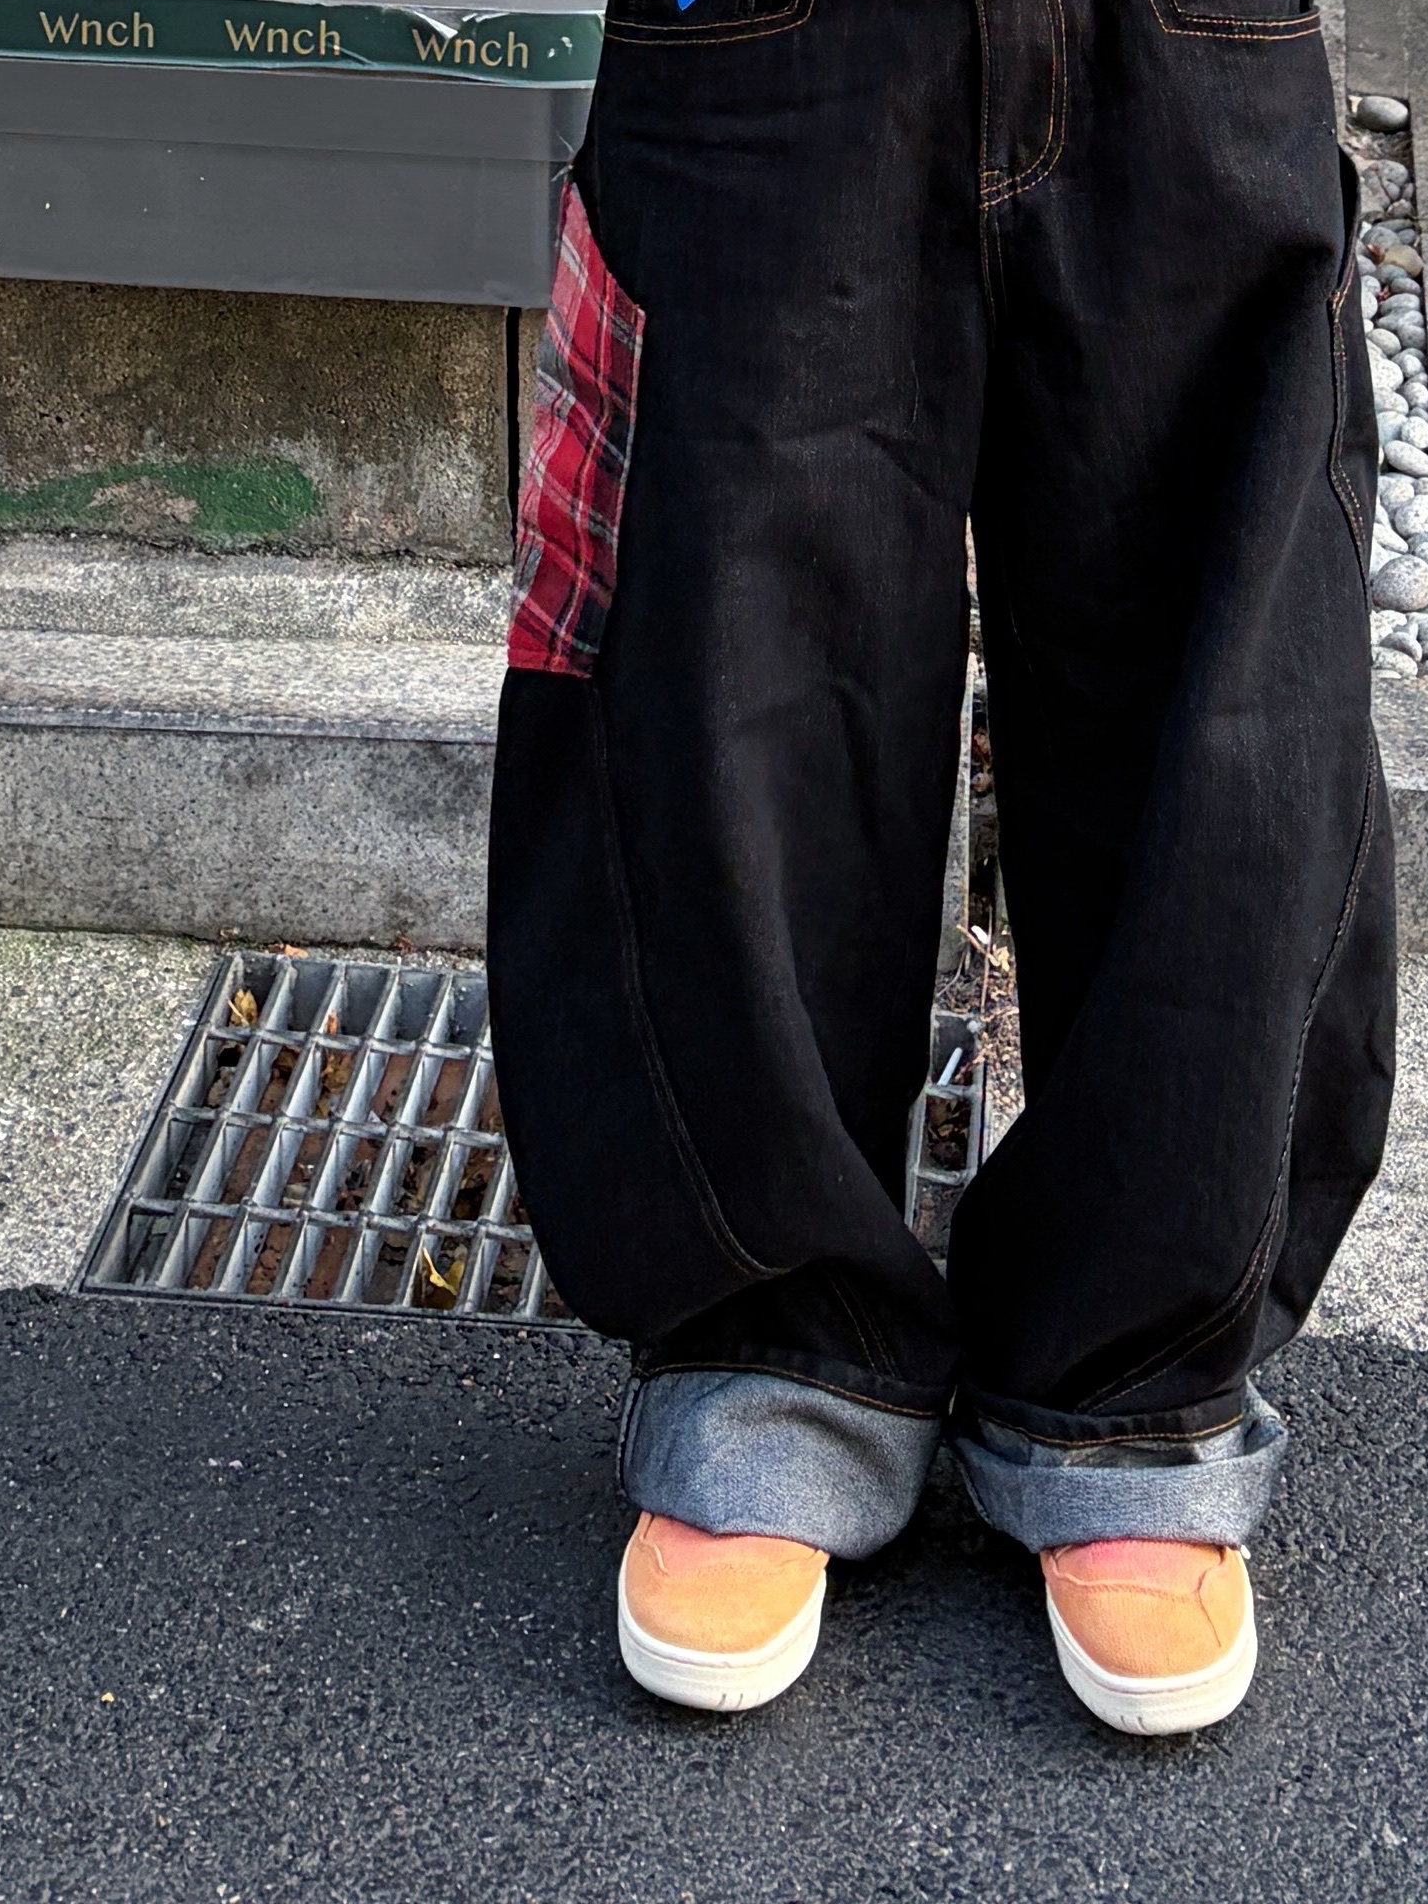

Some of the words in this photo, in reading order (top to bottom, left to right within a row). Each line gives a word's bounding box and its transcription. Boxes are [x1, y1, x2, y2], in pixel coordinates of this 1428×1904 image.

[39, 9, 156, 51] Wnch
[224, 17, 342, 58] Wnch
[412, 27, 529, 69] Wnch
